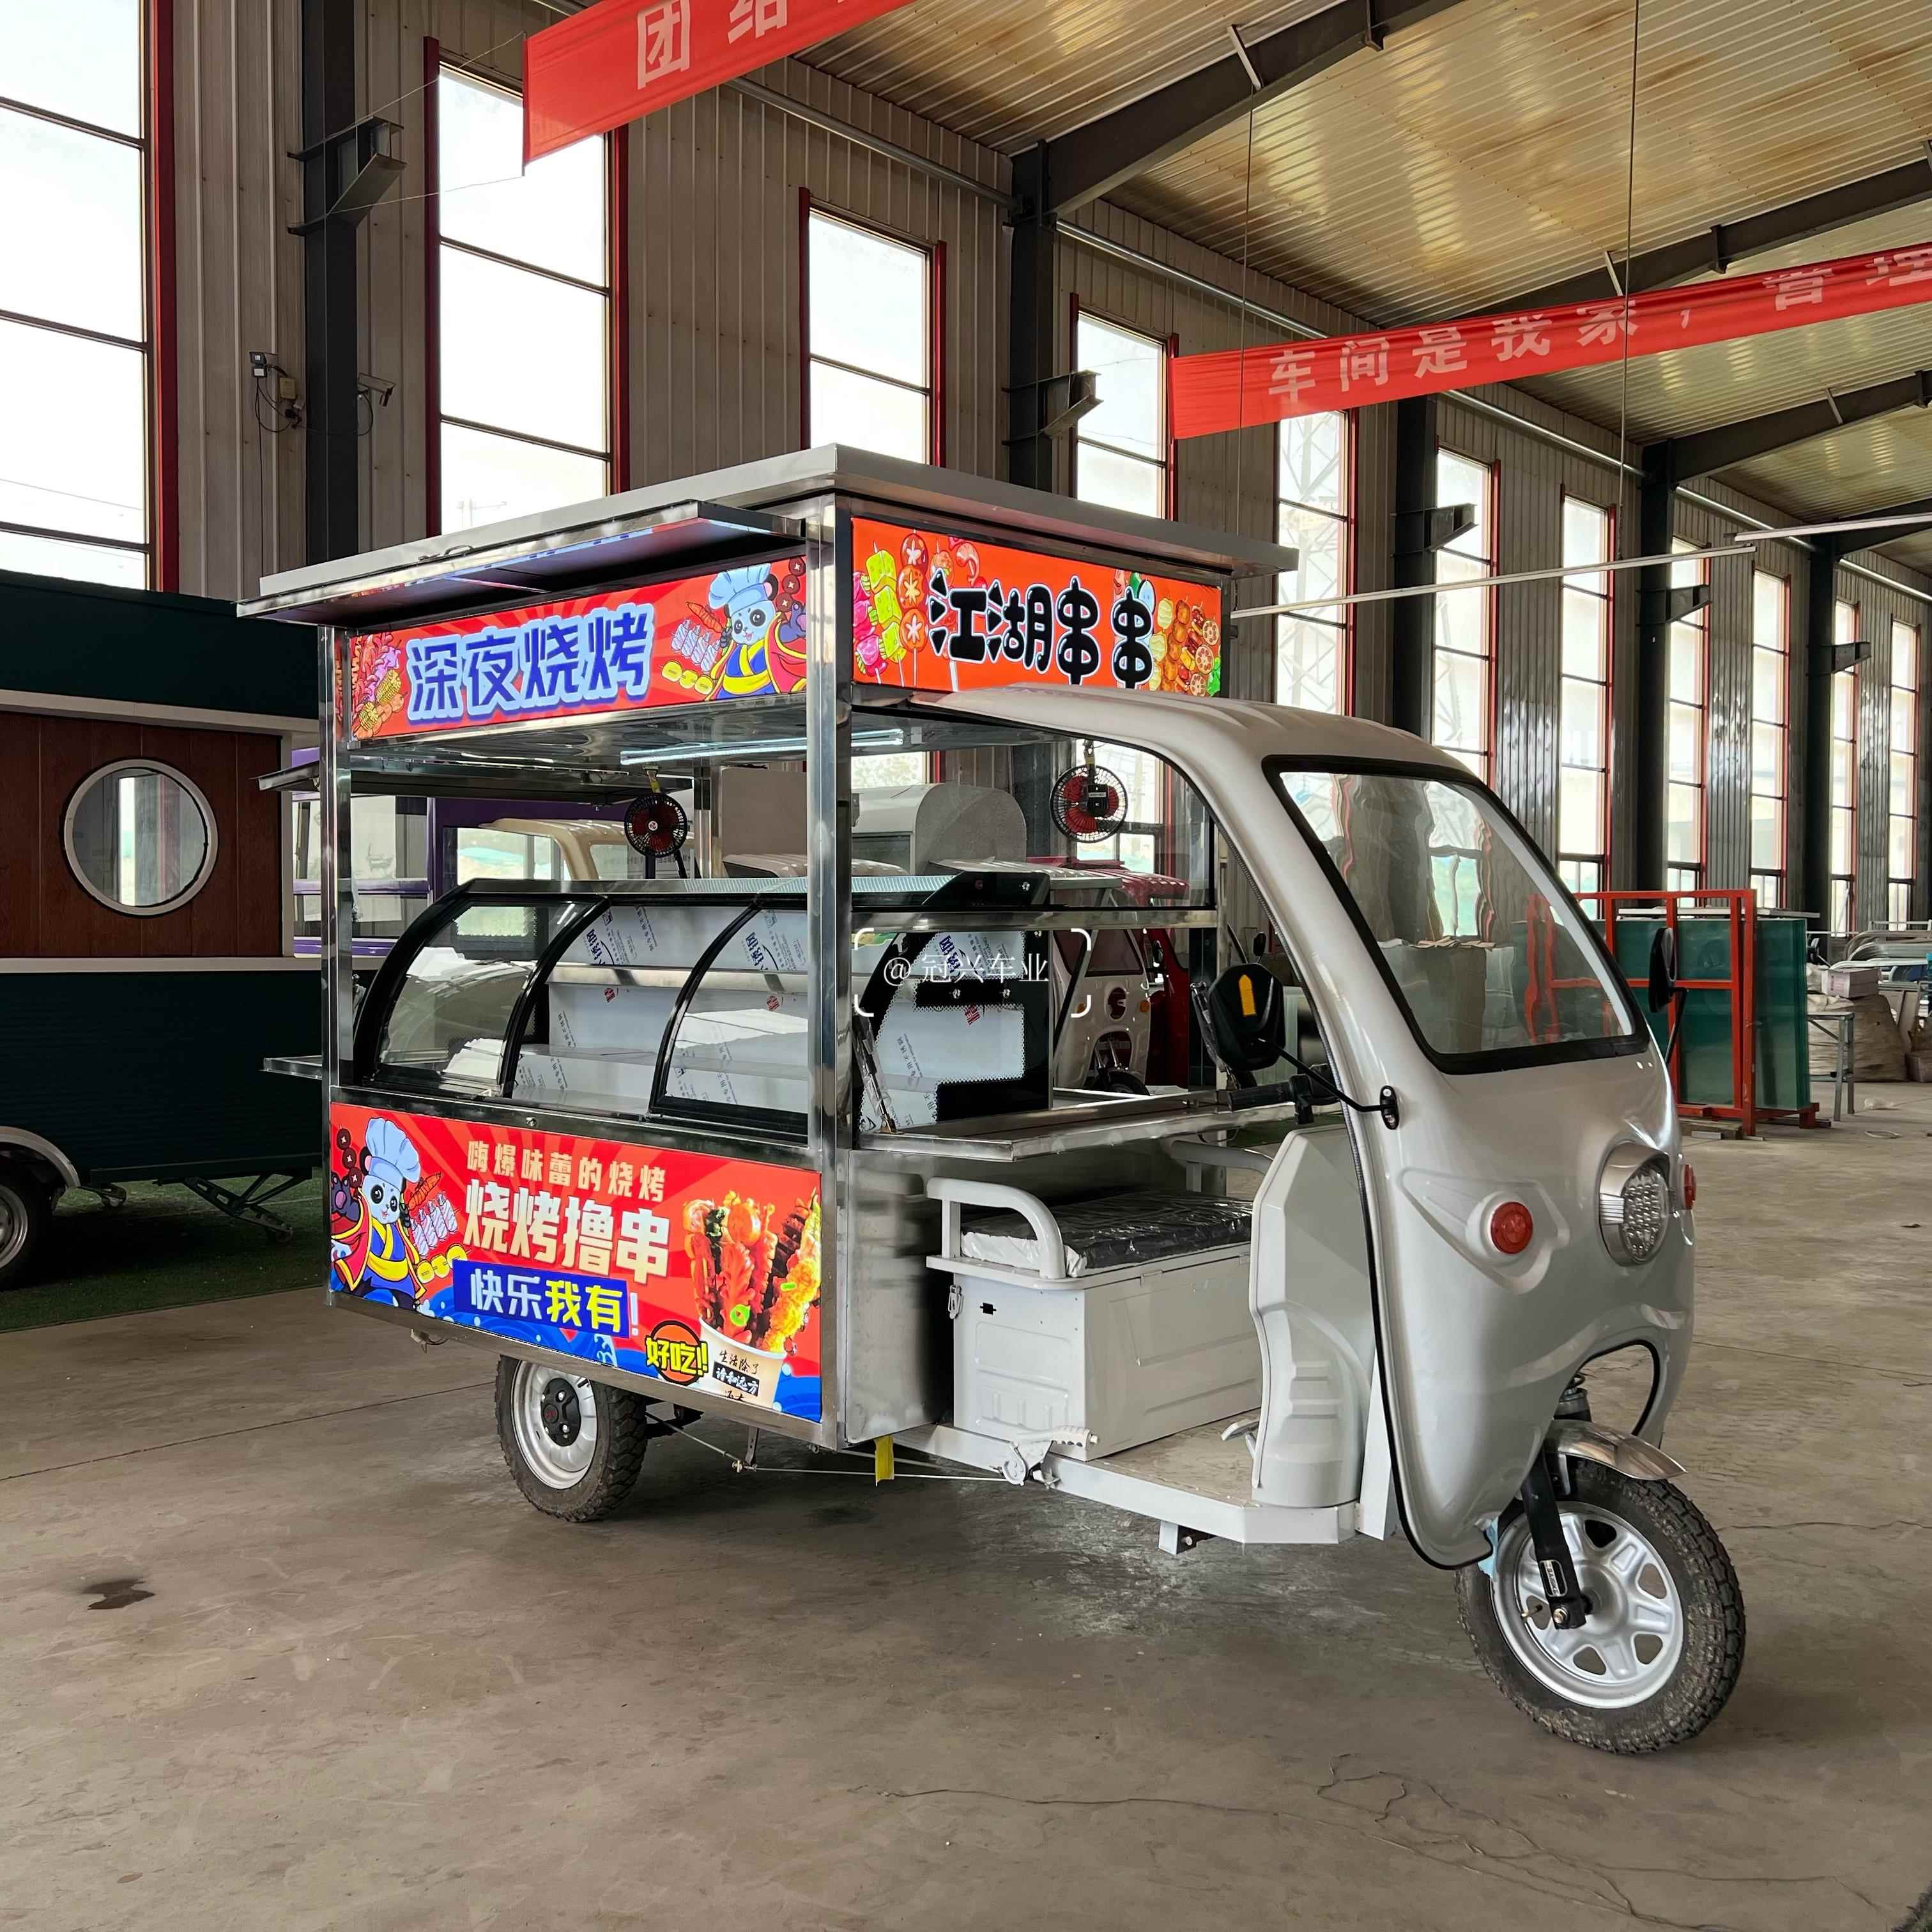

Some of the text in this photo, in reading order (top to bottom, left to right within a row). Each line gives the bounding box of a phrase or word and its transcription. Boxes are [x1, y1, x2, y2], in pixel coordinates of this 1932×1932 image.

[408, 604, 653, 721] 深夜烧烤
[928, 567, 1154, 689] 江湖串串
[466, 1140, 665, 1202] 嗨爆味蕾的烧烤
[463, 1179, 671, 1284] 烧烤撸串
